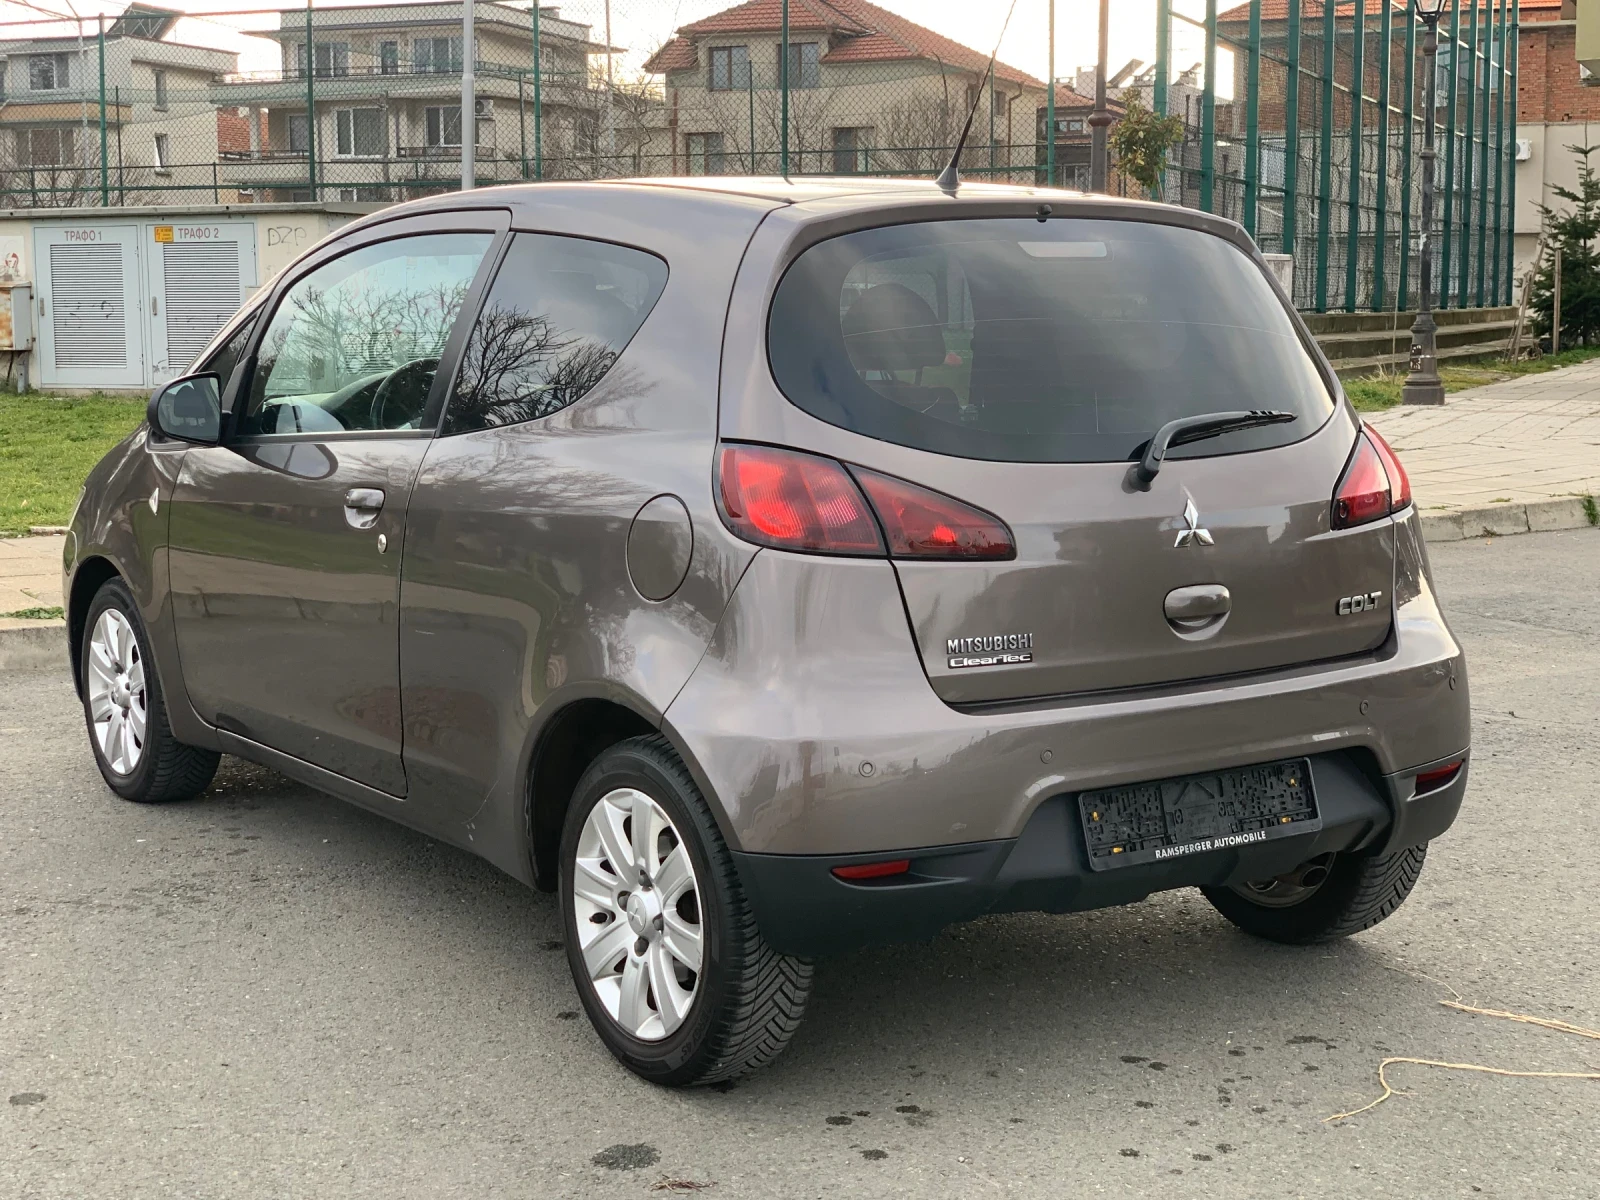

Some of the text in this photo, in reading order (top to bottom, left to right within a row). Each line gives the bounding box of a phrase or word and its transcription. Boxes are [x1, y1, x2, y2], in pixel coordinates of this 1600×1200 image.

[64, 230, 102, 242] ТРАФО 1
[178, 227, 211, 240] ТРАФО
[213, 227, 219, 239] 2
[1337, 590, 1382, 616] COLT
[947, 633, 1033, 653] MITSUBISHI
[949, 653, 1031, 667] ClearTec
[1155, 831, 1267, 858] RAMSPERGER AUTOMOBILE
